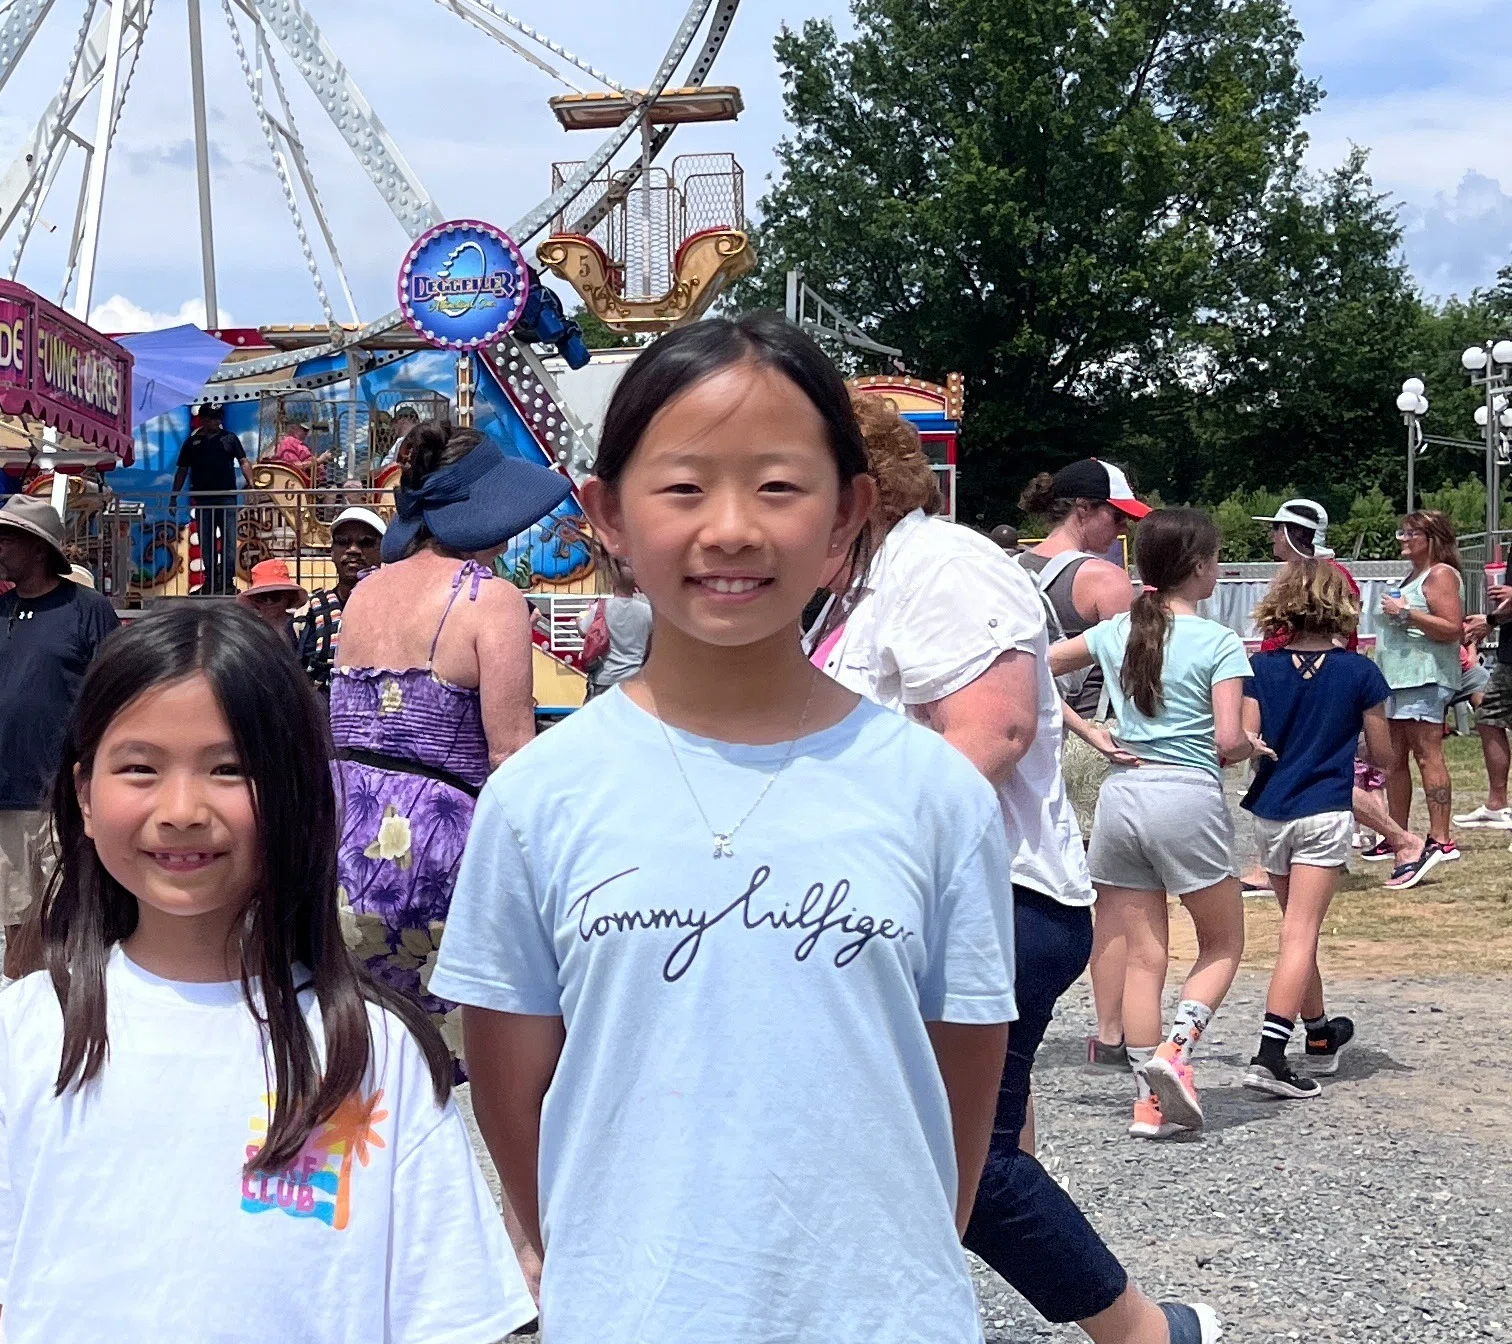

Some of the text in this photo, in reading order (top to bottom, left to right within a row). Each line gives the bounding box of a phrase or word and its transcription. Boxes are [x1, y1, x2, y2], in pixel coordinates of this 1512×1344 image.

[579, 254, 591, 278] 5
[566, 866, 710, 983] Tommy
[241, 1175, 316, 1212] CLUB
